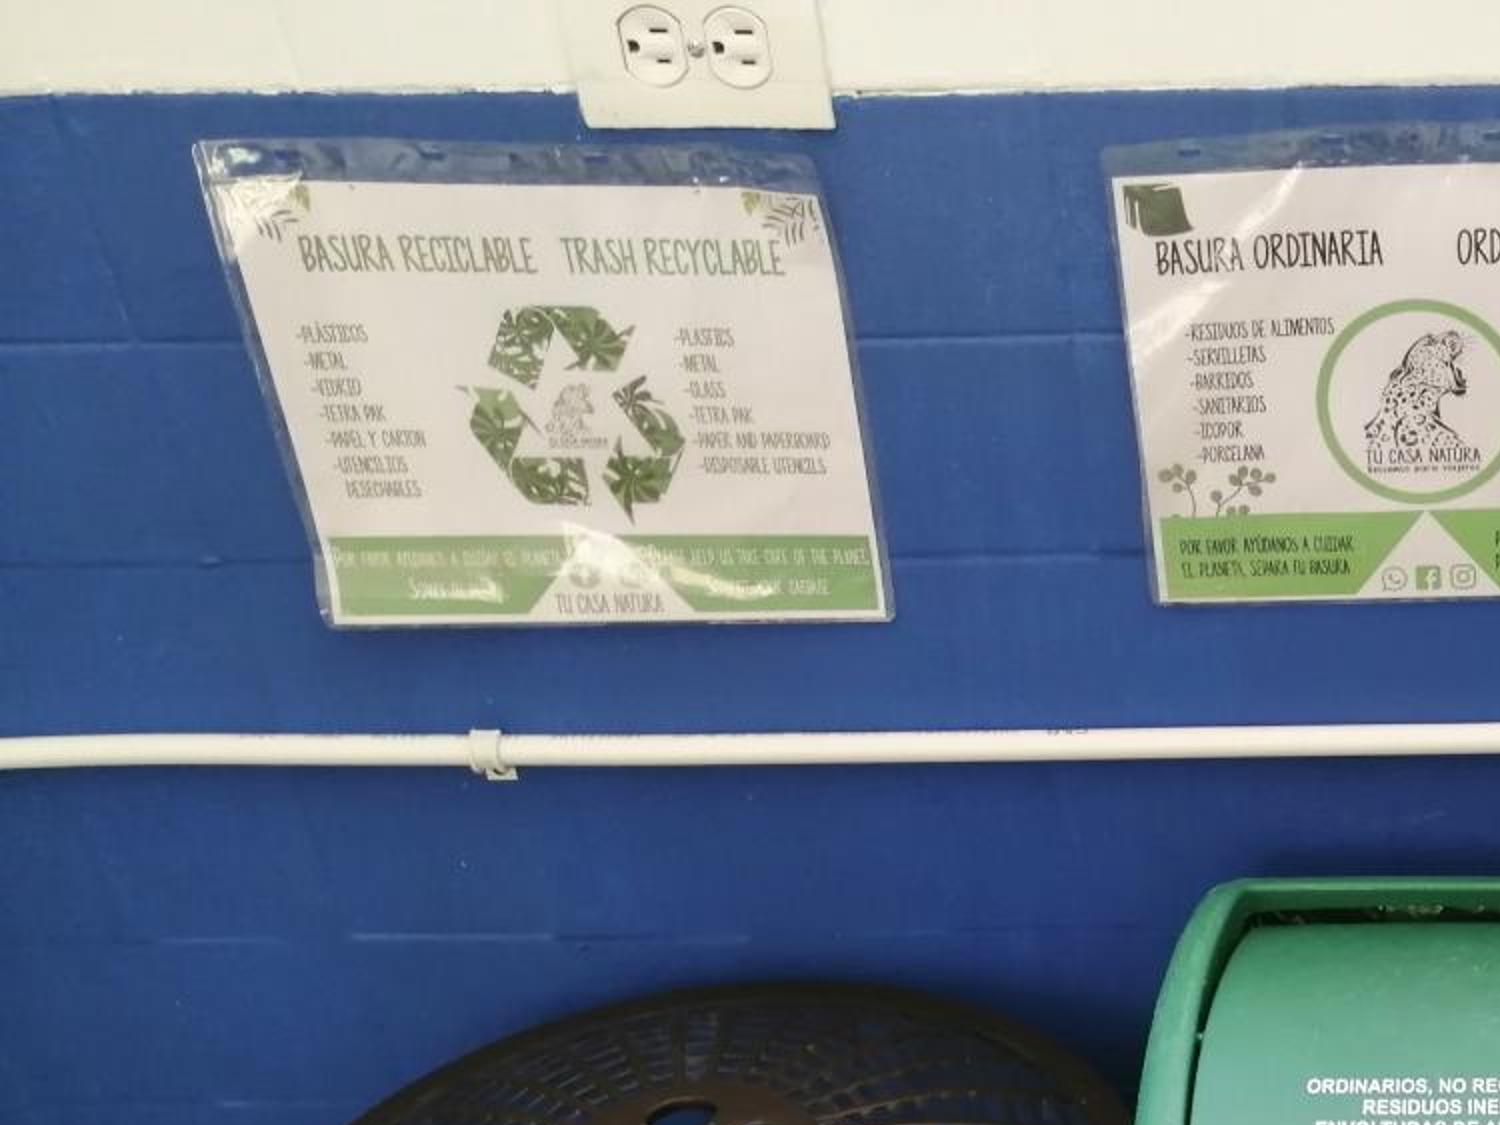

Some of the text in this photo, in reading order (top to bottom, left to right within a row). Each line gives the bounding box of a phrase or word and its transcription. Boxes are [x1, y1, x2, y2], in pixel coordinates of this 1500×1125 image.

[298, 235, 539, 274] BASURA RECICLABLE
[560, 237, 786, 276] TRASH RECYCLABLE
[1155, 230, 1384, 276] BASURA ORDINARIA
[1252, 320, 1265, 339] DE
[1270, 317, 1335, 337] ALIMENTOS
[1367, 447, 1480, 464] TU CASA NATURA
[1303, 536, 1310, 550] A
[555, 592, 664, 614] TU CASA NATURA
[1307, 1078, 1433, 1096] ORDINARIOS,
[1439, 1078, 1467, 1094] NO
[1362, 1099, 1462, 1115] RESIDUOS
